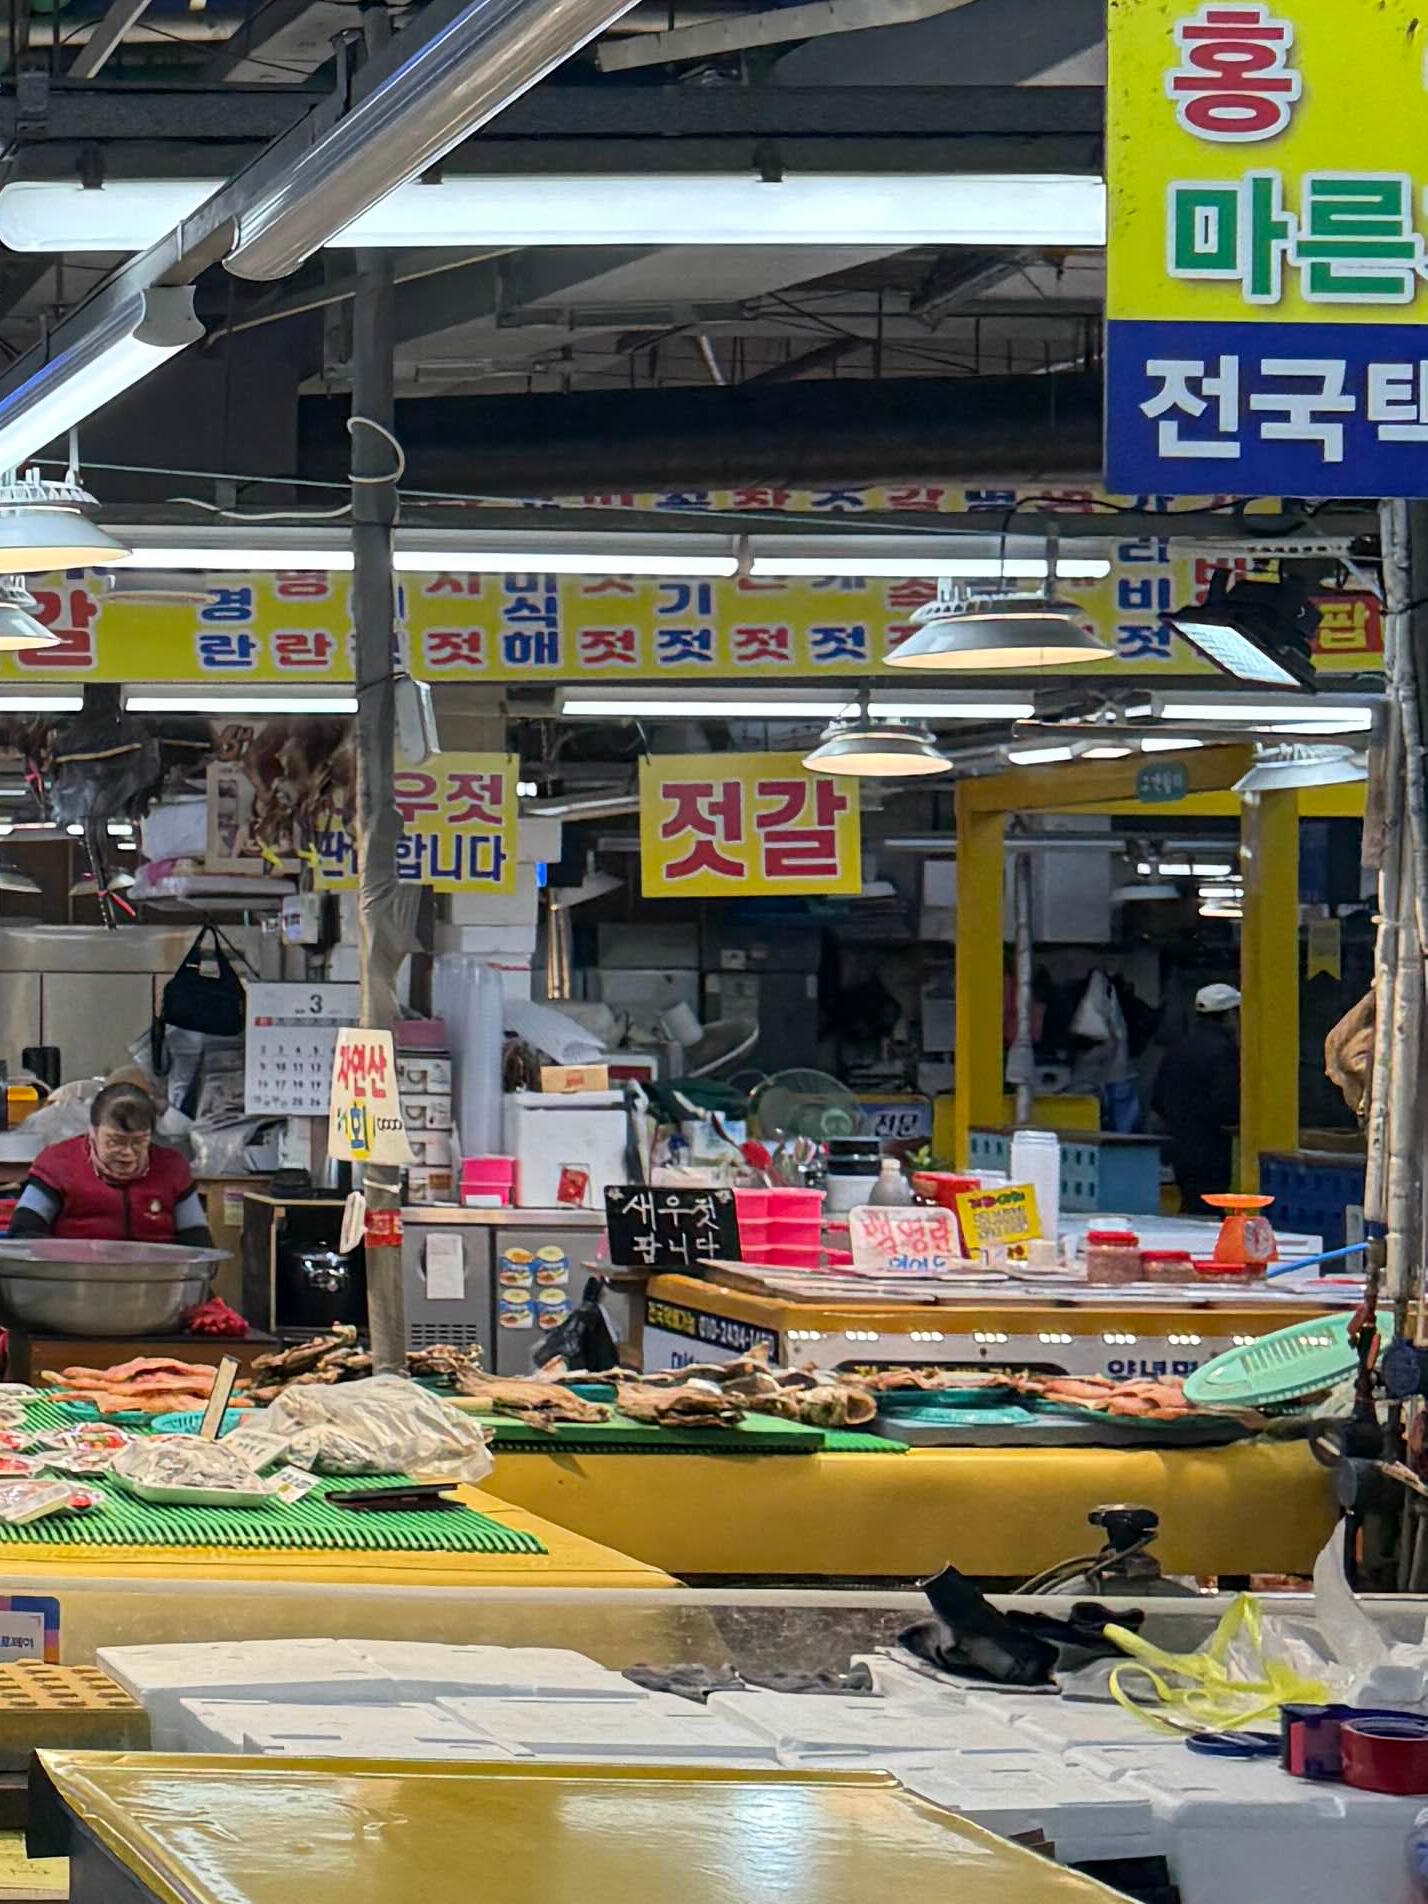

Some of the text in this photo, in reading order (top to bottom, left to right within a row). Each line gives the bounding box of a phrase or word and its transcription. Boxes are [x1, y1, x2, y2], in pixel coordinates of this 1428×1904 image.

[1173, 10, 1293, 134] 홍
[1175, 175, 1428, 297] 마른
[319, 831, 507, 882] 판합니다
[660, 779, 849, 879] 젓갈
[310, 993, 323, 1014] 3
